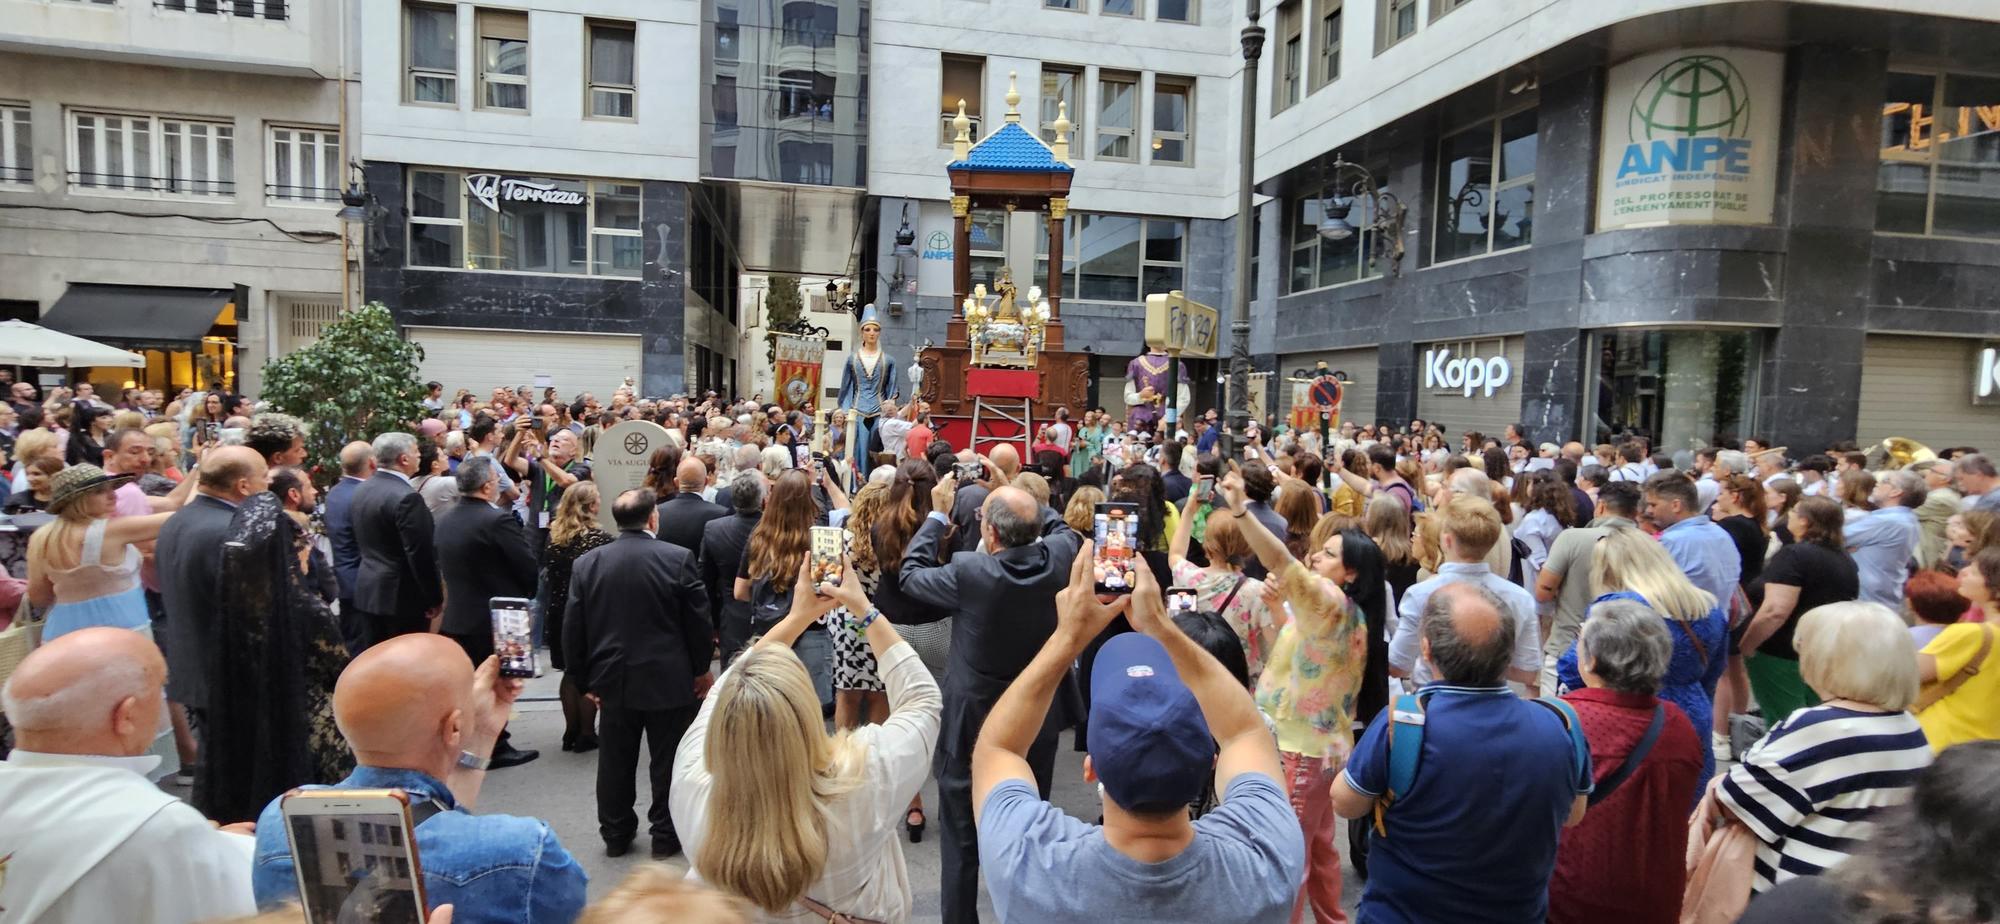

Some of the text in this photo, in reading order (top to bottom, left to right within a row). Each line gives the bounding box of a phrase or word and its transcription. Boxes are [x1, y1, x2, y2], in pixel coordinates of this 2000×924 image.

[1616, 136, 1752, 180] ANPE
[1615, 173, 1668, 189] SINDICAT
[501, 179, 584, 205] Terrazza
[1614, 196, 1632, 207] DEL
[1639, 191, 1731, 202] PROFESSORAT
[922, 250, 955, 260] ANPE
[1425, 348, 1510, 398] Kapp
